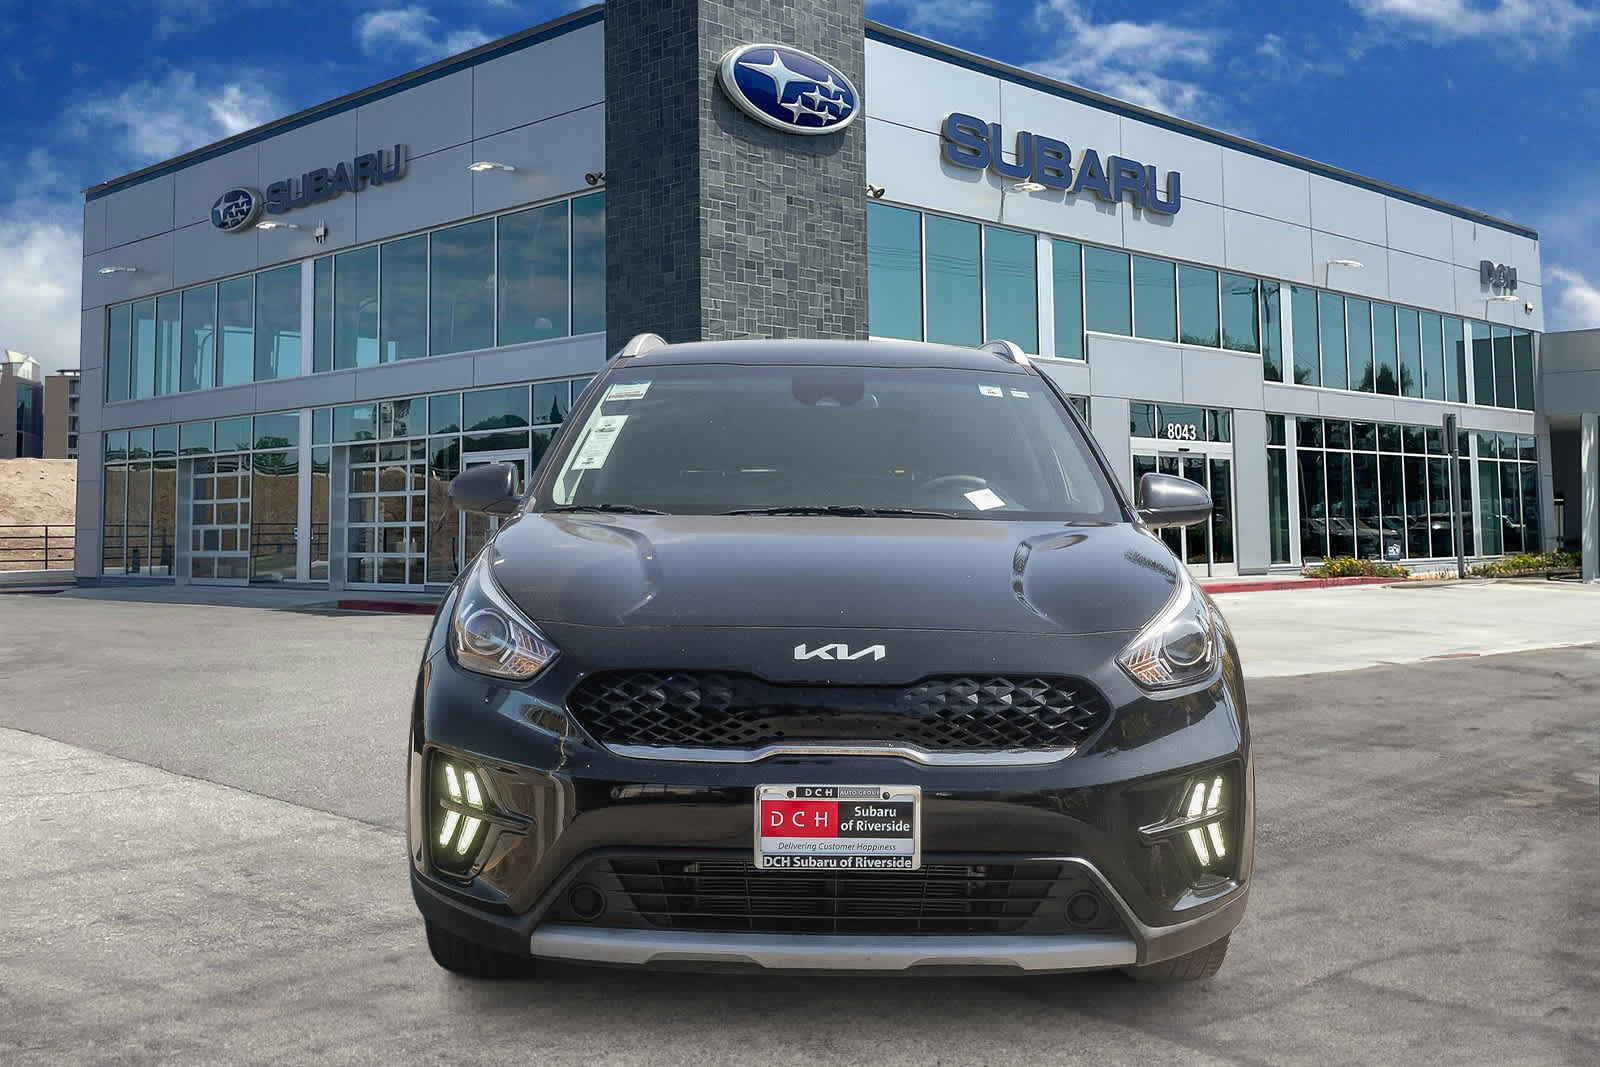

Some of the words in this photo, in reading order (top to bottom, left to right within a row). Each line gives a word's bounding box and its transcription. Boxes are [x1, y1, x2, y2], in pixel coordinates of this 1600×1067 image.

[941, 112, 1181, 215] SUBARU
[266, 143, 404, 215] SUBARU
[1167, 423, 1196, 440] 8043
[804, 788, 833, 797] DCH
[854, 805, 897, 817] Subaru
[770, 811, 828, 827] DCH
[840, 820, 853, 831] of
[856, 820, 911, 832] Riverside
[778, 842, 817, 851] Delivering
[818, 843, 856, 851] Customer
[857, 843, 896, 852] Happiness
[763, 856, 791, 867] DCH
[793, 857, 837, 868] Subaru
[839, 857, 853, 868] of
[856, 857, 912, 868] Riverside
